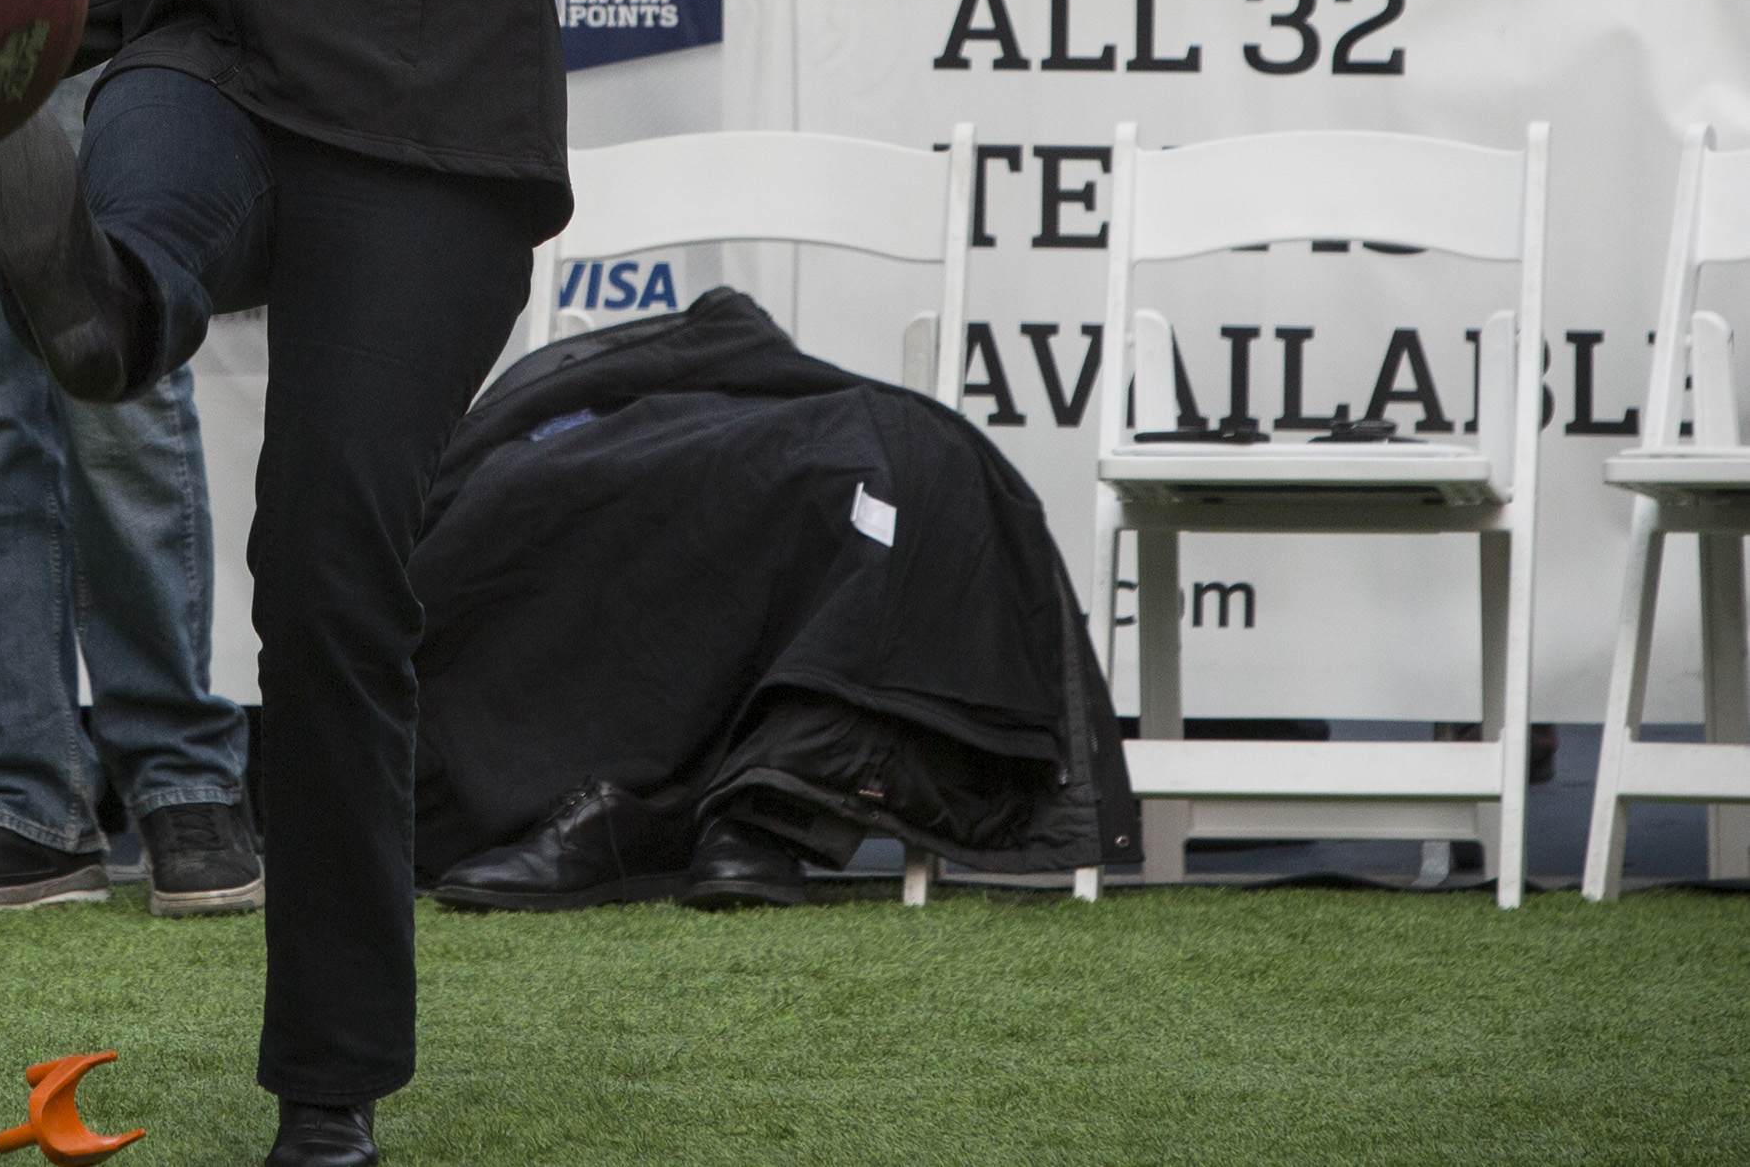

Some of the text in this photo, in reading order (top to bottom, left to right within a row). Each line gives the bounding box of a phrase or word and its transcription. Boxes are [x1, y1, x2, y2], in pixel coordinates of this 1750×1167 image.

[569, 4, 679, 28] POINTS
[558, 261, 678, 310] VISA
[962, 321, 1734, 438] AVILAL
